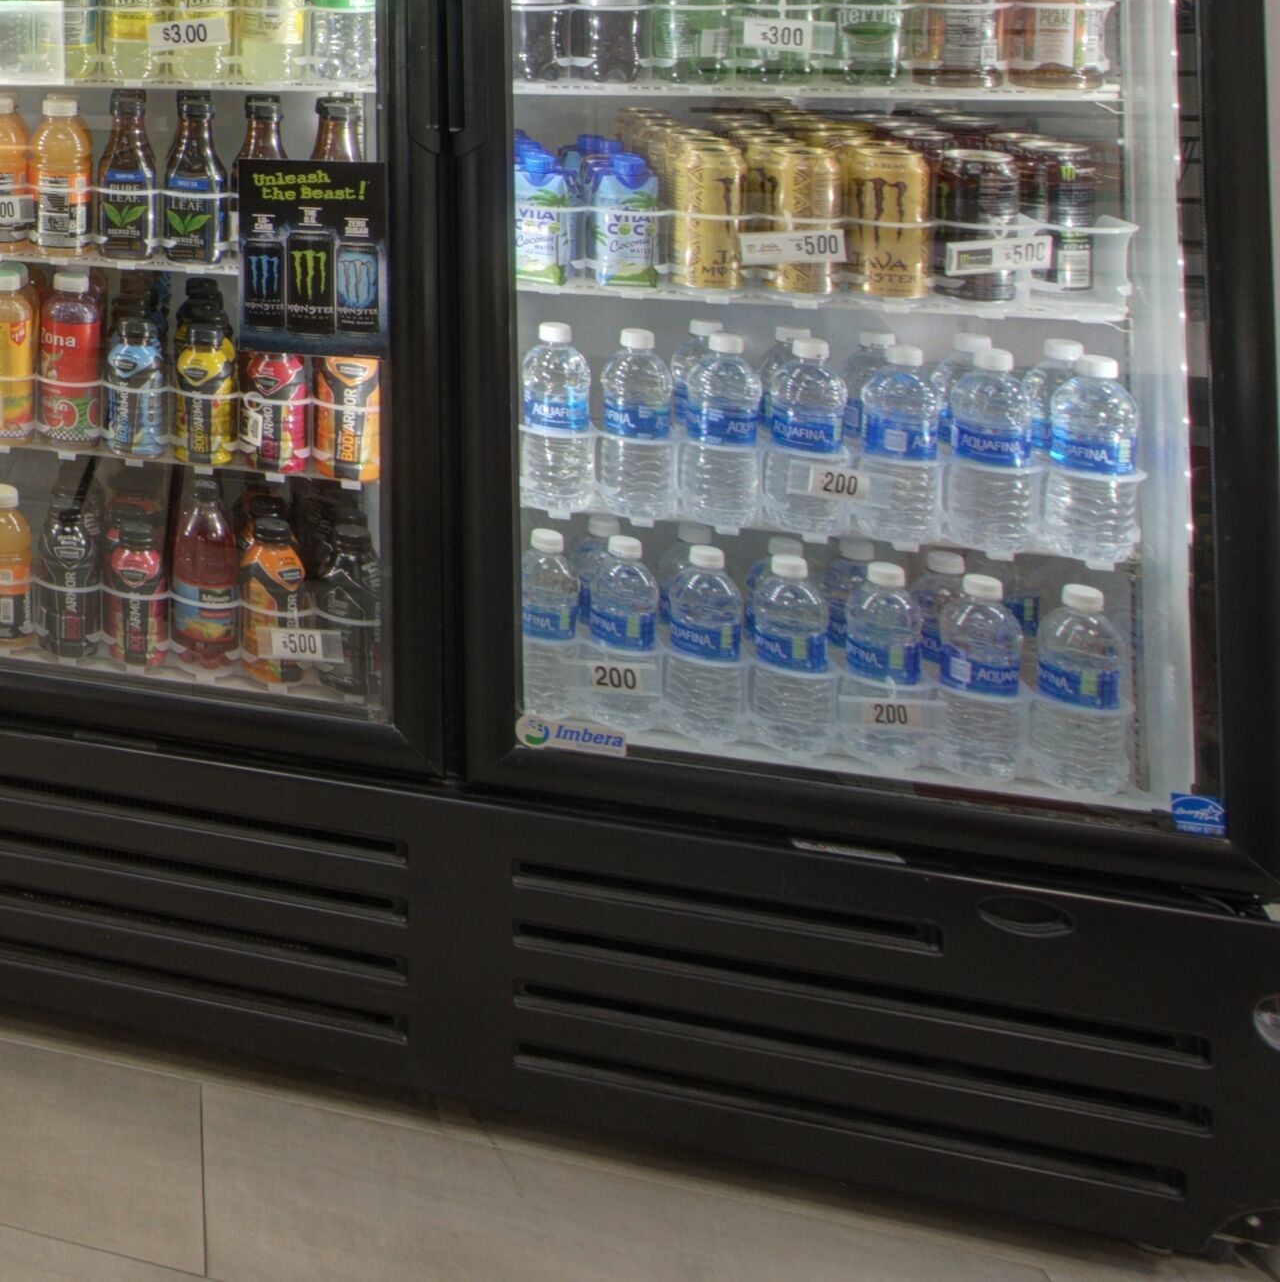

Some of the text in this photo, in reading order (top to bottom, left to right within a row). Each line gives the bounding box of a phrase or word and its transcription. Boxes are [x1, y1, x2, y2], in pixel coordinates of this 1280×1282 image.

[163, 23, 208, 44] $3.00
[252, 169, 332, 188] Unleash
[262, 180, 366, 202] the Beast!
[254, 222, 274, 231] CARB
[345, 226, 369, 235] SUGAR
[348, 220, 367, 228] ZERO
[852, 251, 908, 271] JAVA
[287, 303, 335, 316] MONSTER
[41, 327, 77, 349] Zona
[531, 401, 583, 419] AQUAFI
[605, 406, 632, 424] FINA
[340, 387, 359, 462] BODYARMOR
[727, 420, 757, 435] AQUA
[773, 420, 827, 442] AQUAFINA
[960, 434, 1021, 455] AQUAFINA
[1060, 444, 1109, 462] UAFINA
[592, 615, 619, 636] FINA
[671, 624, 713, 647] UAFINA
[756, 636, 784, 657] FINA
[846, 646, 879, 667] FINA
[976, 669, 1019, 685] AQUAF
[1040, 667, 1070, 691] FINA
[554, 724, 625, 749] Imbera
